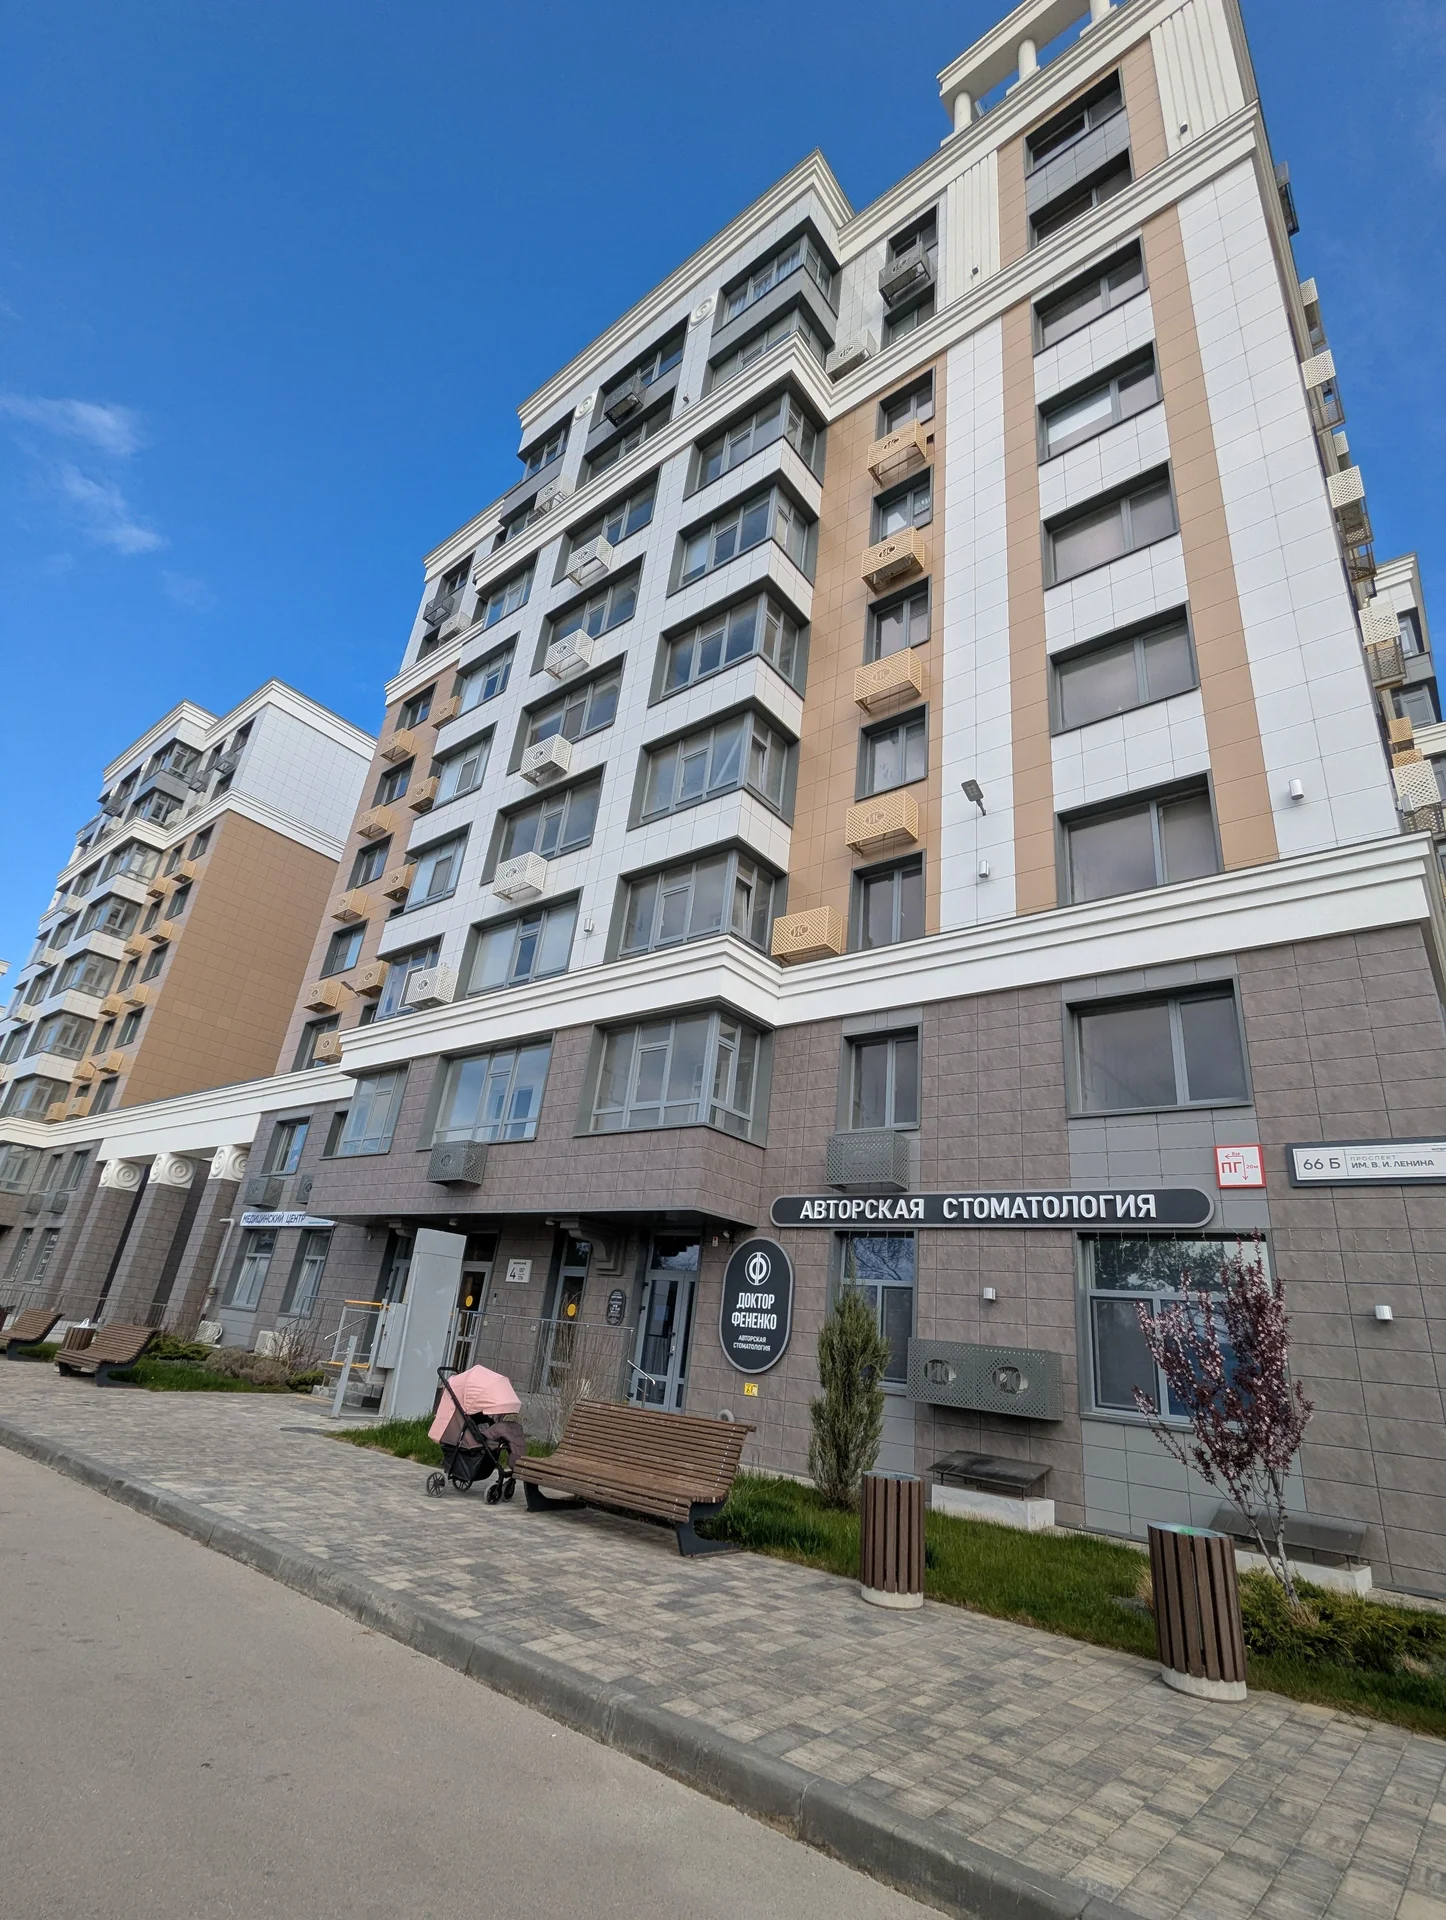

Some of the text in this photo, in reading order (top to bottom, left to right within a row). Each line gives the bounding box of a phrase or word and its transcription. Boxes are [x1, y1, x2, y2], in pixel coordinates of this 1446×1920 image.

[1221, 1161, 1242, 1174] ПГ
[1303, 1157, 1341, 1170] 66 Б
[1351, 1161, 1369, 1169] ИМ.
[1393, 1159, 1434, 1168] ЛЕНИНА
[800, 1194, 1157, 1220] АВТОРСКАЯ СТОМАТОЛОГИЯ
[242, 1212, 306, 1225] МЕДИЦИНСКИЙ ЦЕНТР
[509, 1267, 516, 1280] 4
[736, 1292, 775, 1309] ДОКТОР
[731, 1311, 777, 1330] ФЕНЕНКО
[738, 1334, 767, 1343] АВТОРСКАЯ
[733, 1342, 771, 1352] СТОМАТОЛОГИЯ
